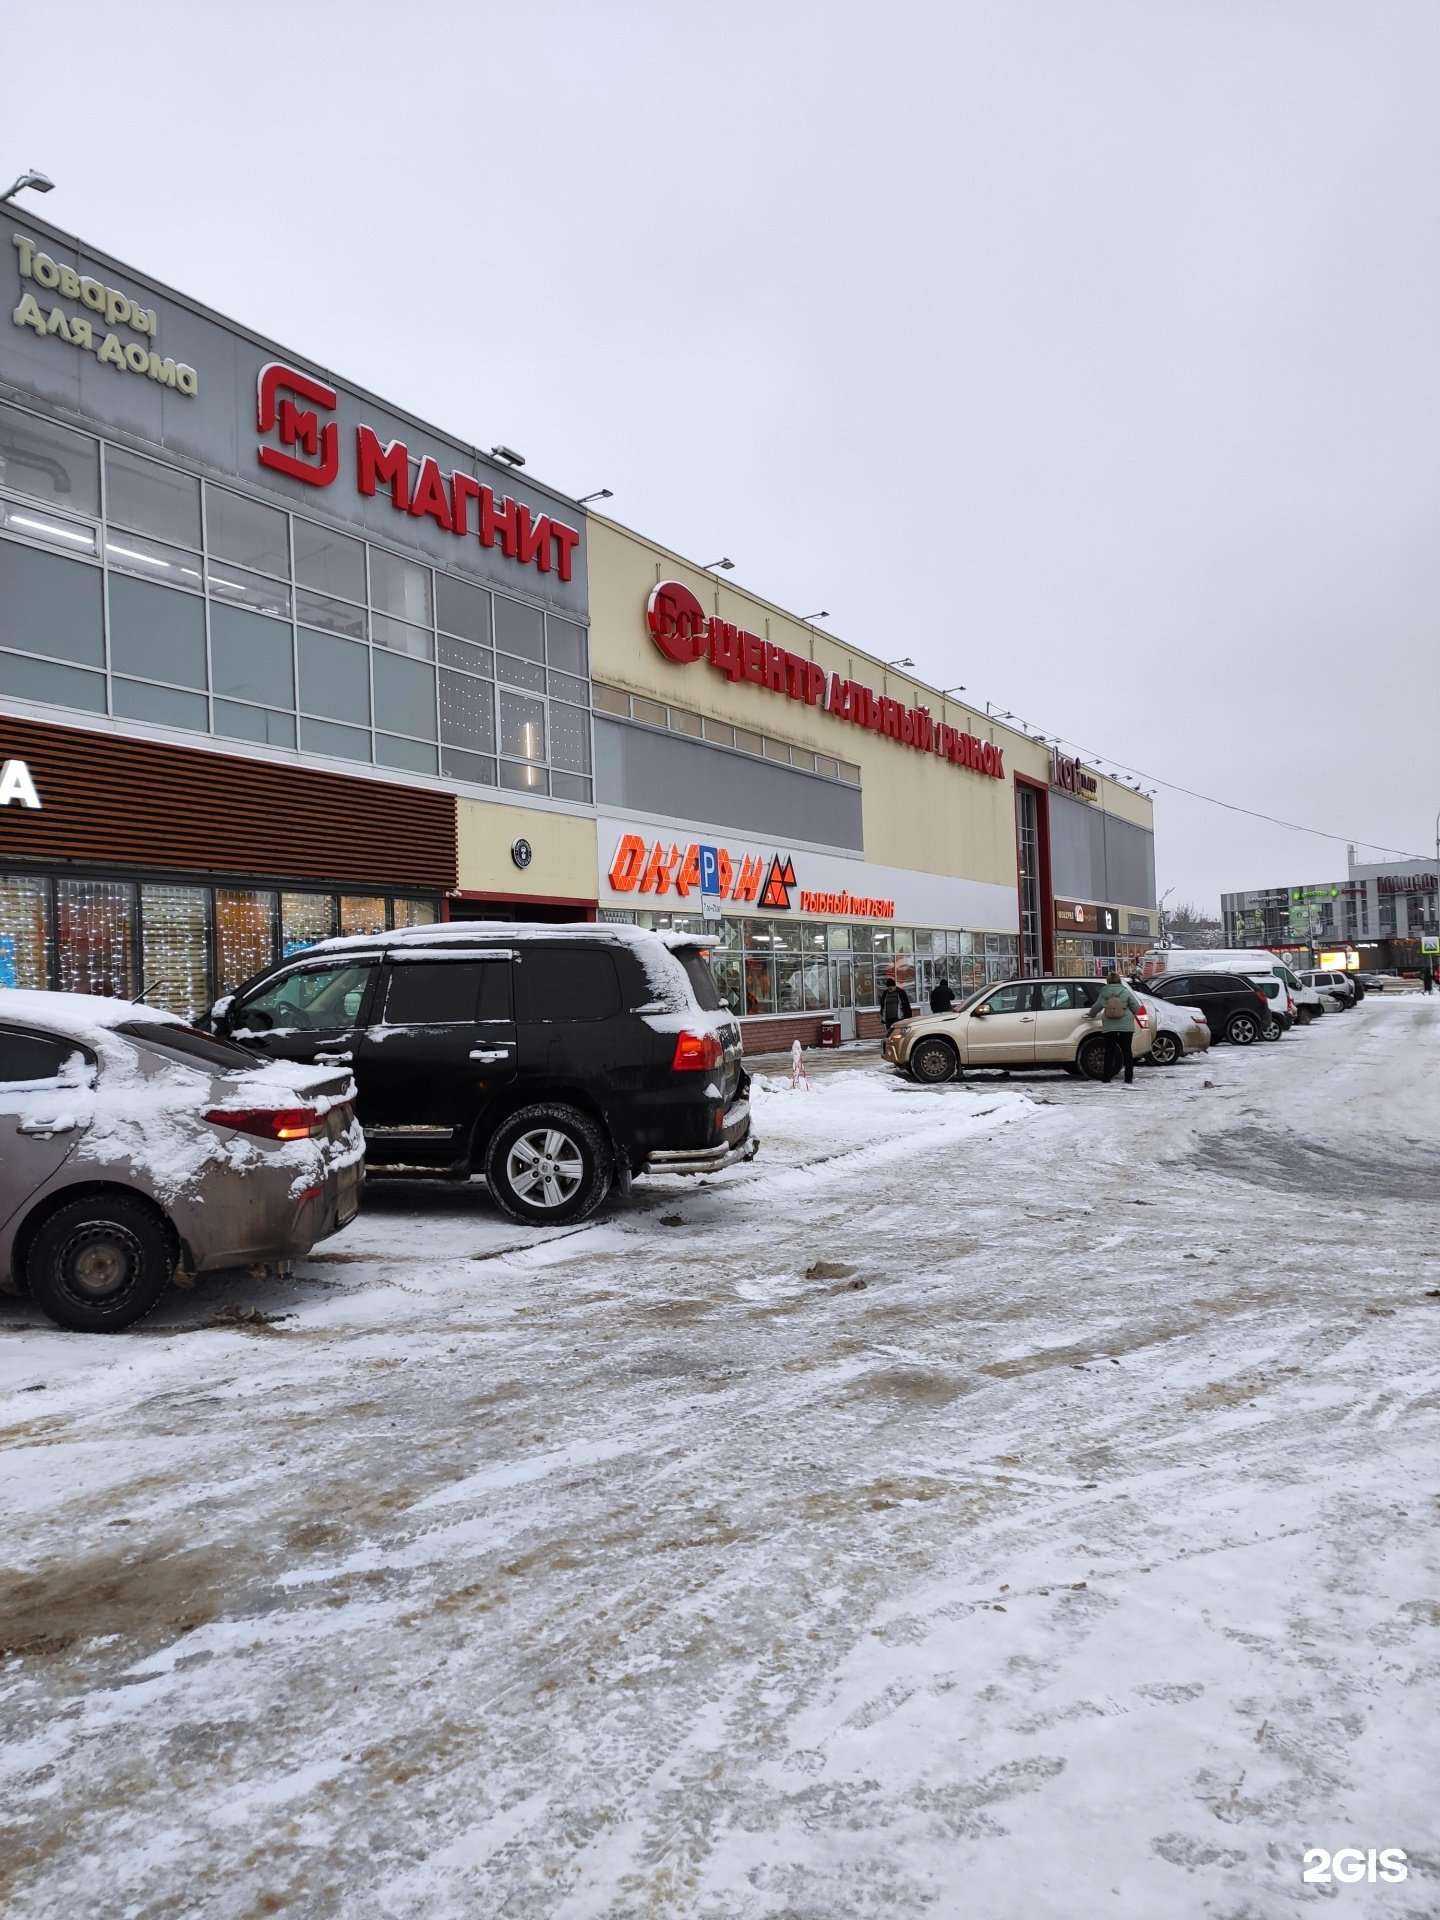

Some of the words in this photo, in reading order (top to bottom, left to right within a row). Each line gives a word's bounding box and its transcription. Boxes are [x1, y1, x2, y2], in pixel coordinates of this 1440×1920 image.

[13, 233, 157, 337] Товары
[97, 333, 198, 397] дома
[356, 422, 580, 582] МАГНИТ
[708, 614, 934, 753] ЦЕНТРАЛЬНЫЙ
[936, 721, 1006, 780] РЫНОК
[800, 888, 848, 914] РЫБНЫЙ
[849, 896, 895, 919] МАГАЗИН
